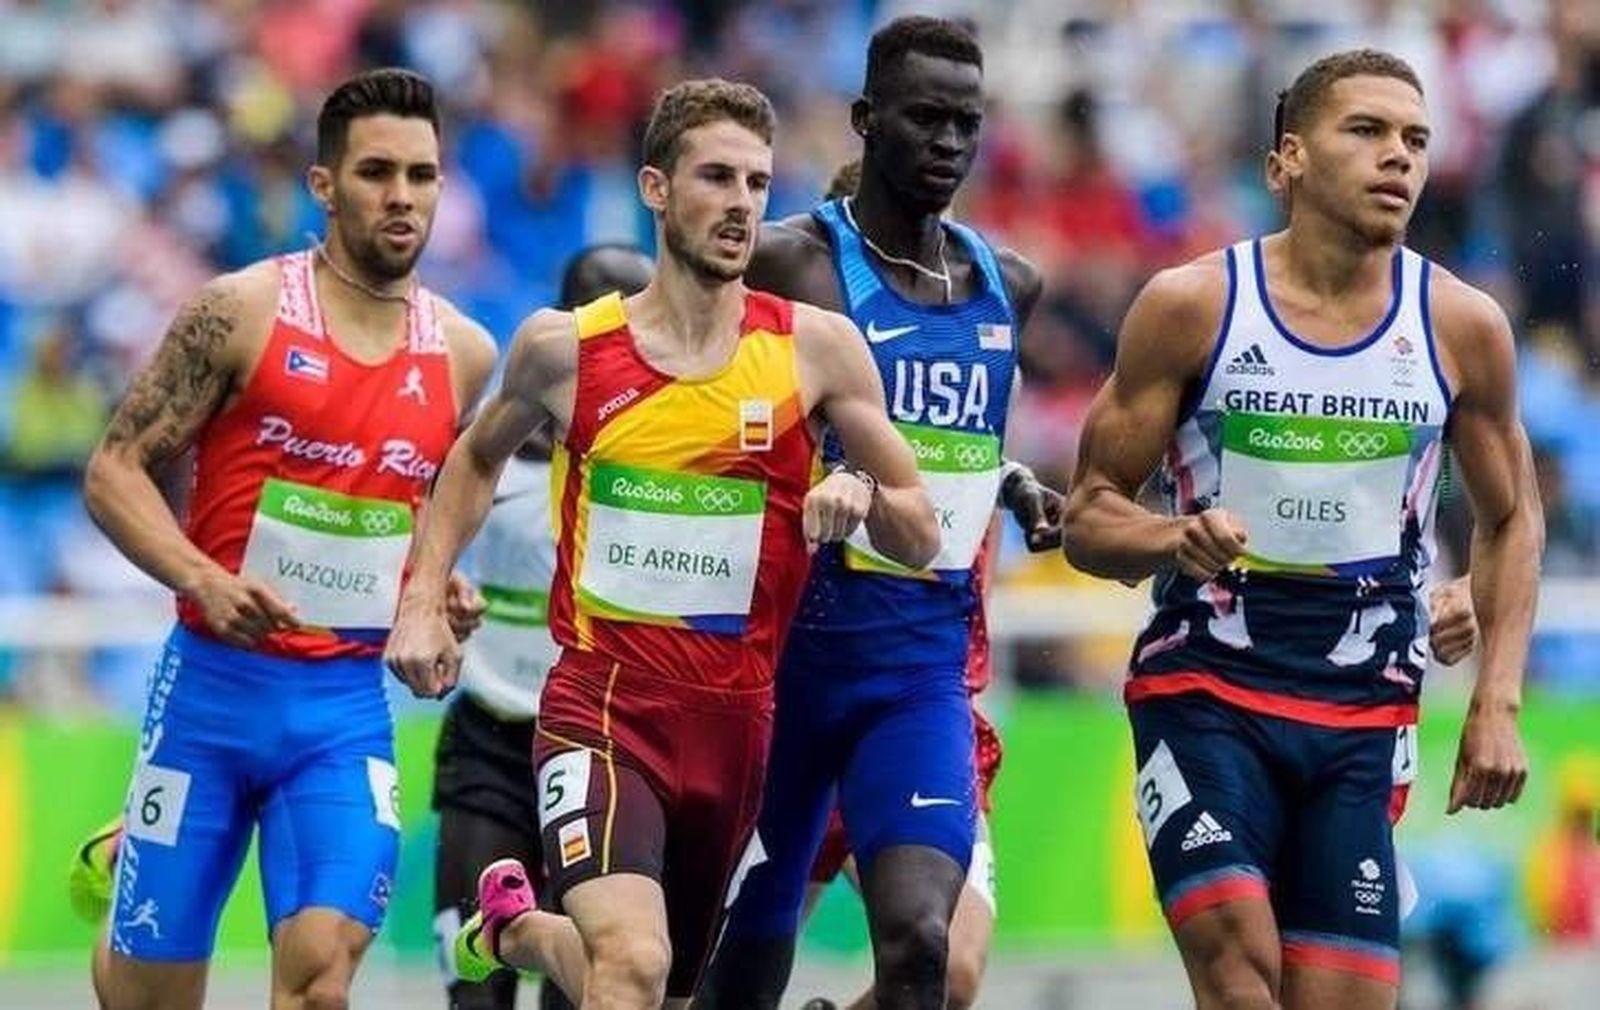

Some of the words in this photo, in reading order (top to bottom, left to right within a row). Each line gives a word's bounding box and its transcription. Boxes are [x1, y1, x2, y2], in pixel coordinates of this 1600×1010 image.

[1226, 364, 1275, 377] adidas
[892, 360, 989, 428] USA
[1225, 389, 1314, 414] GREAT
[1321, 395, 1429, 423] BRITAIN
[256, 416, 366, 467] Puerto
[1249, 428, 1324, 451] Rio2016
[612, 477, 684, 504] Rio2016
[1276, 498, 1347, 522] GILES
[277, 556, 380, 594] VAZQUEZ
[608, 543, 636, 566] DE
[642, 548, 732, 577] ARRIBA
[141, 786, 165, 826] 6
[545, 769, 567, 812] 5
[1141, 777, 1164, 824] 3
